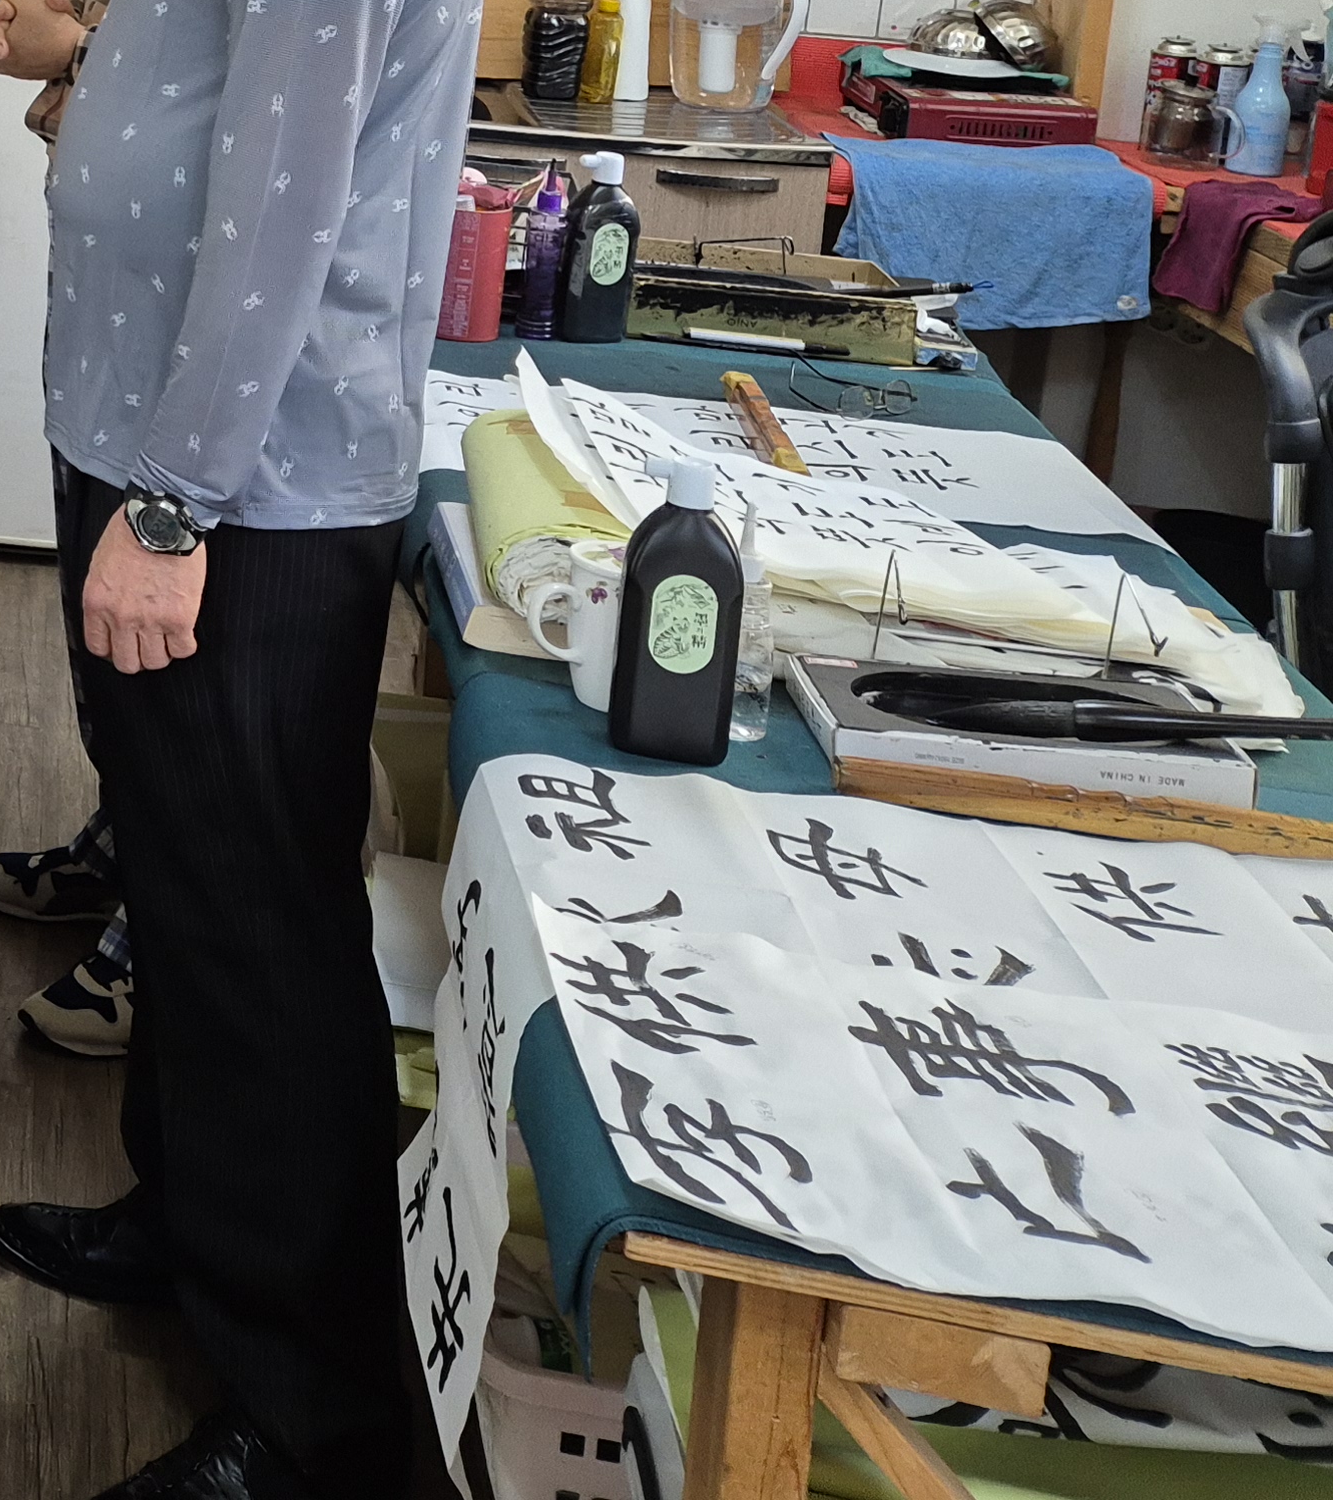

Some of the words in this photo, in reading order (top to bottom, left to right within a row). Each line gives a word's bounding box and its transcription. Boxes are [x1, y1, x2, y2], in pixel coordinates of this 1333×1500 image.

[1099, 770, 1136, 783] CHINA
[1140, 775, 1151, 785] IN
[1157, 776, 1186, 787] MADE
